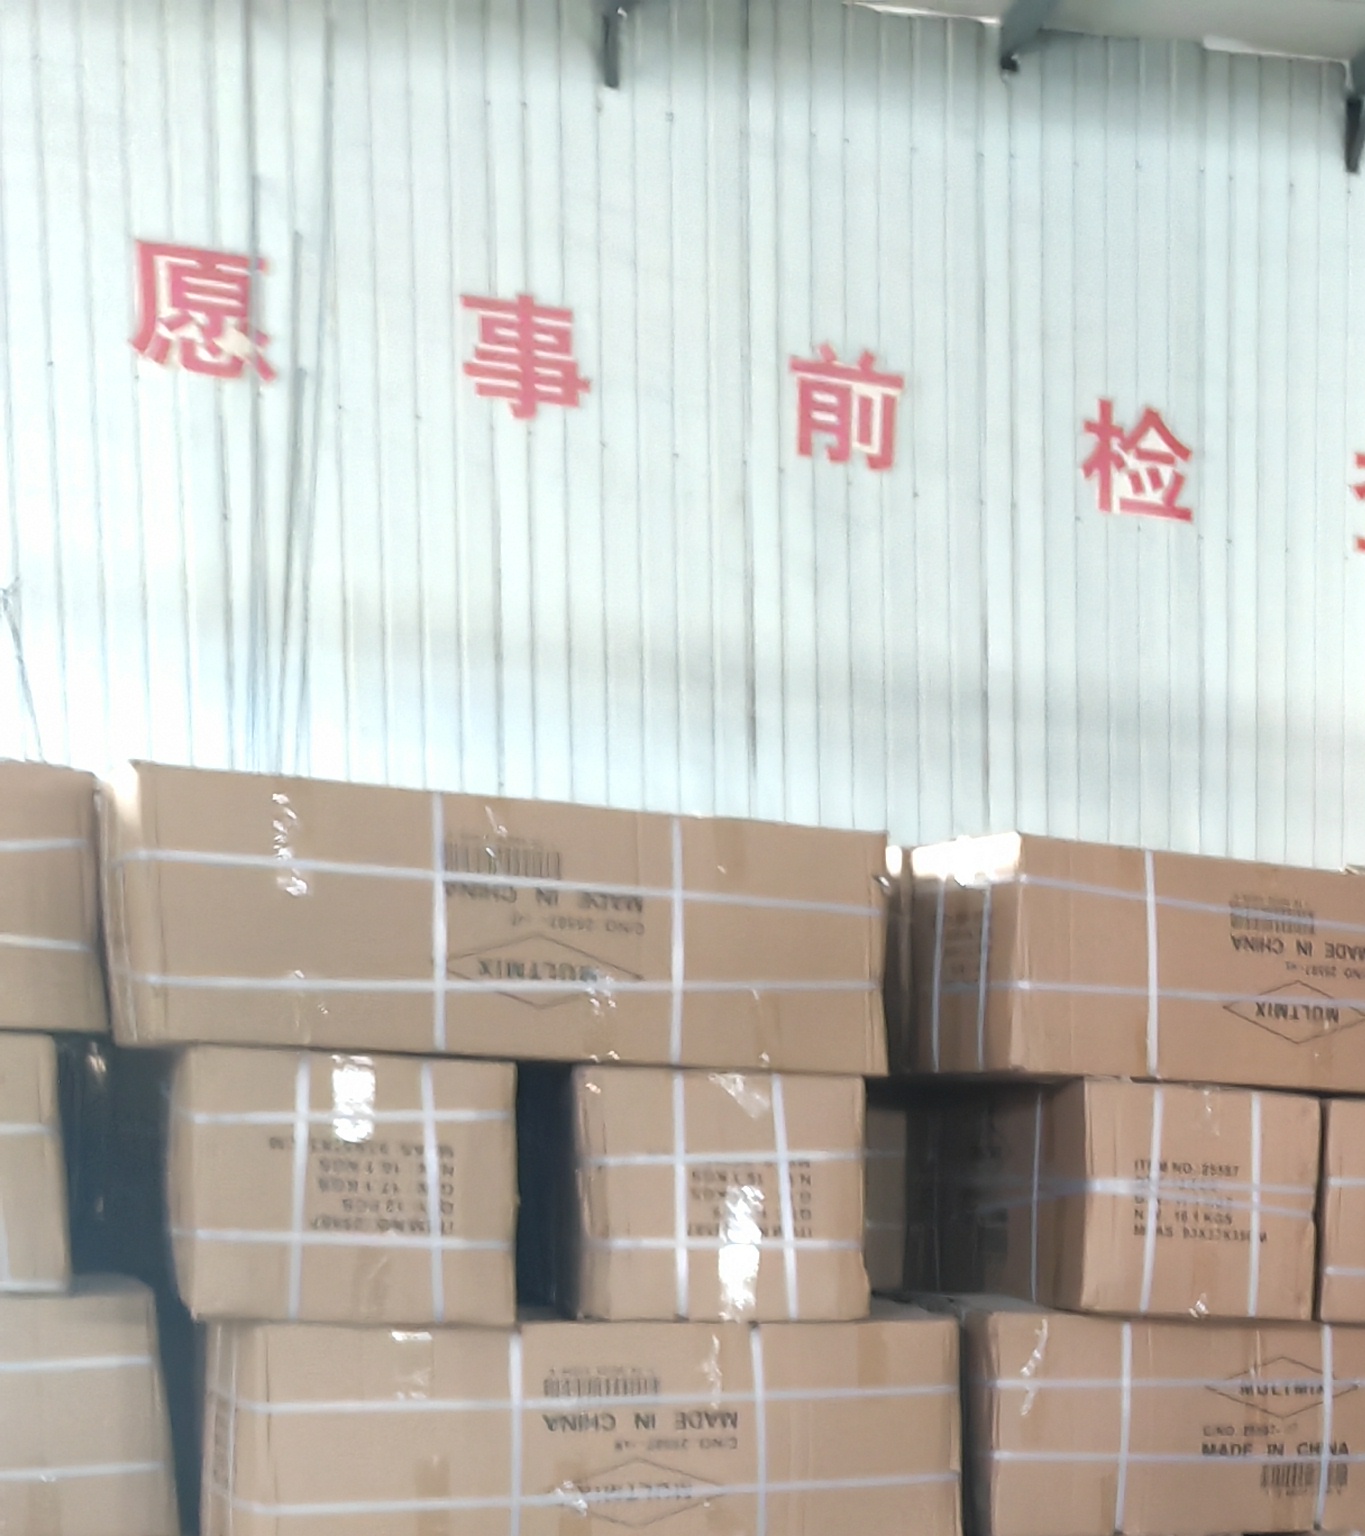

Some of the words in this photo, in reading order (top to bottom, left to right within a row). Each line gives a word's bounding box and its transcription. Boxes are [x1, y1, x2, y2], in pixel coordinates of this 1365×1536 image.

[1230, 934, 1285, 955] CHINA
[1296, 940, 1313, 957] IN
[632, 1412, 656, 1430] IN
